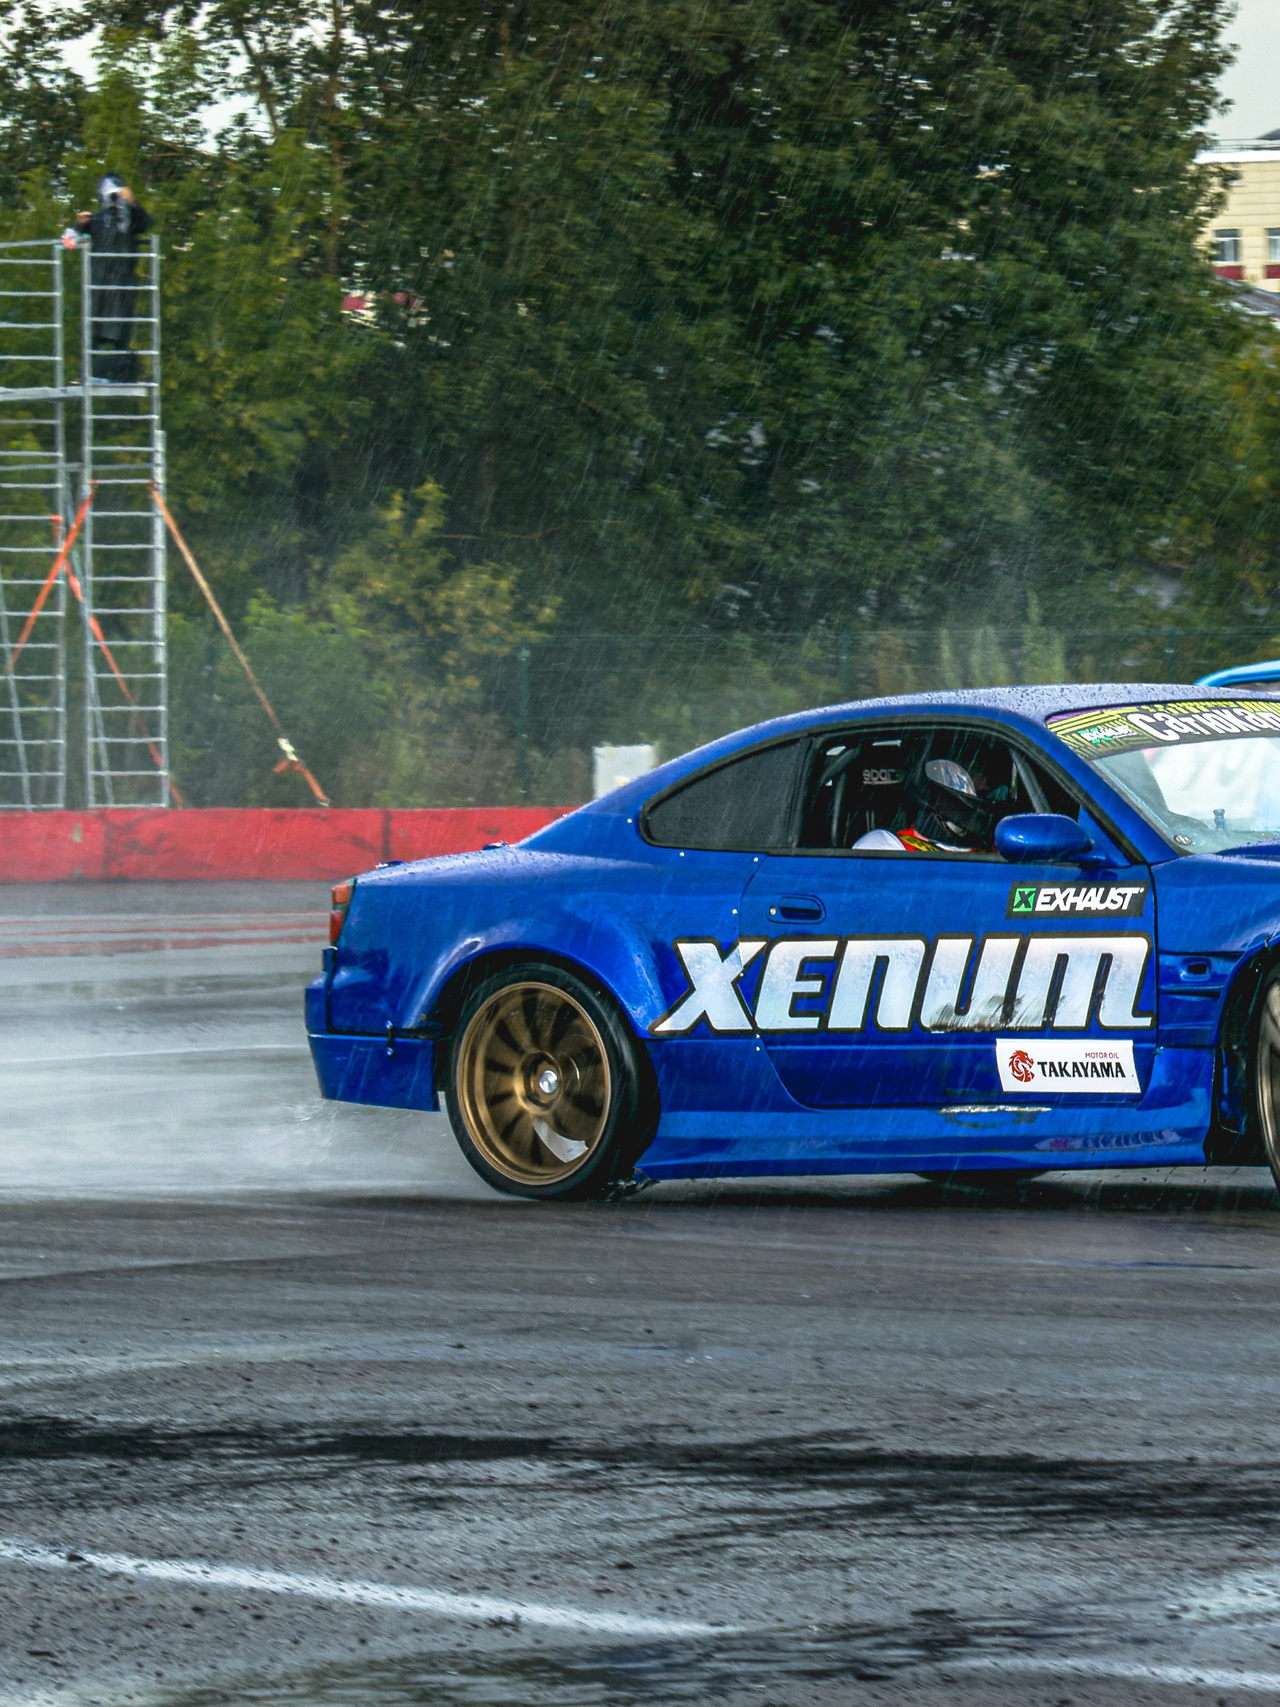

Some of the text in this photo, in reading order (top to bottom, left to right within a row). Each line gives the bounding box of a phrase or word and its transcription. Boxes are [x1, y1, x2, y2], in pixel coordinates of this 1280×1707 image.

[1035, 887, 1141, 912] EXHAUST
[649, 933, 1155, 1035] XENUM
[1037, 1061, 1126, 1078] TAKAYAMA
